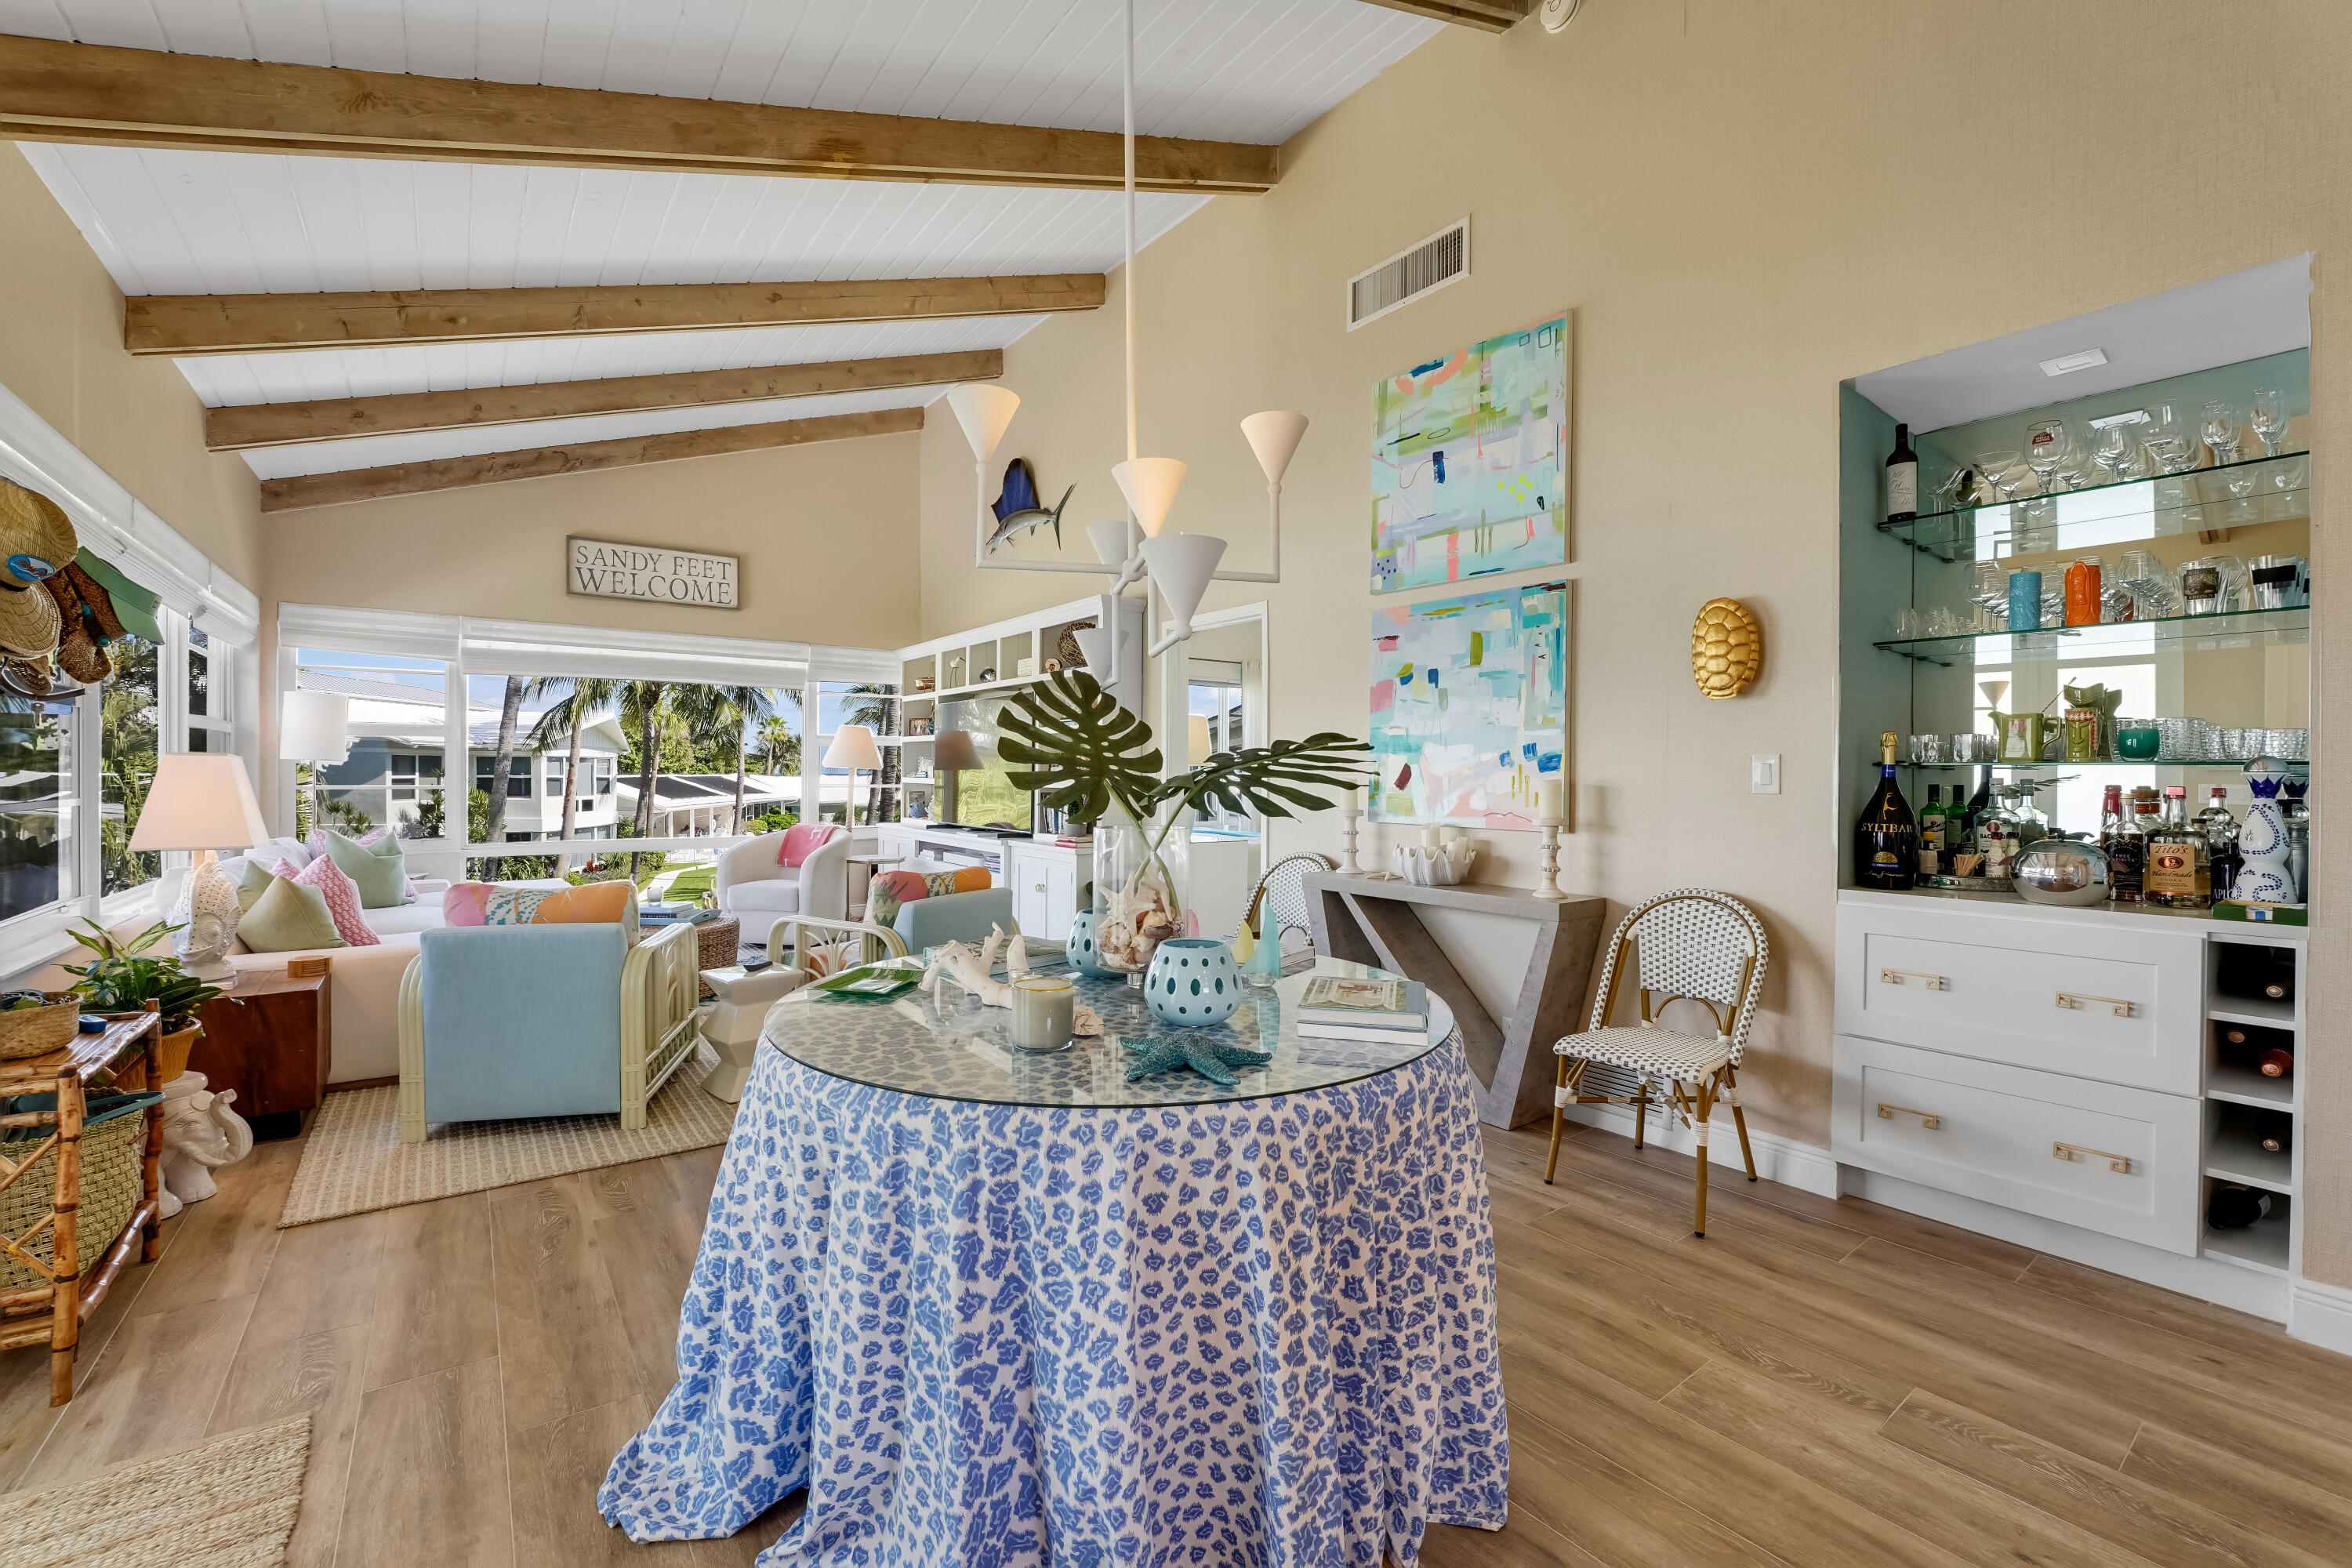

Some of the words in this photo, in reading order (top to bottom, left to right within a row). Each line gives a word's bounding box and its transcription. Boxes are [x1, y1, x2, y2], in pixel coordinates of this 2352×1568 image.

[576, 545, 663, 573] SANDY
[671, 556, 731, 580] FEET
[575, 566, 732, 604] WELCOME
[1861, 822, 1913, 833] SYLTBAR
[2155, 845, 2188, 855] Tito's
[2151, 869, 2193, 878] Handmade
